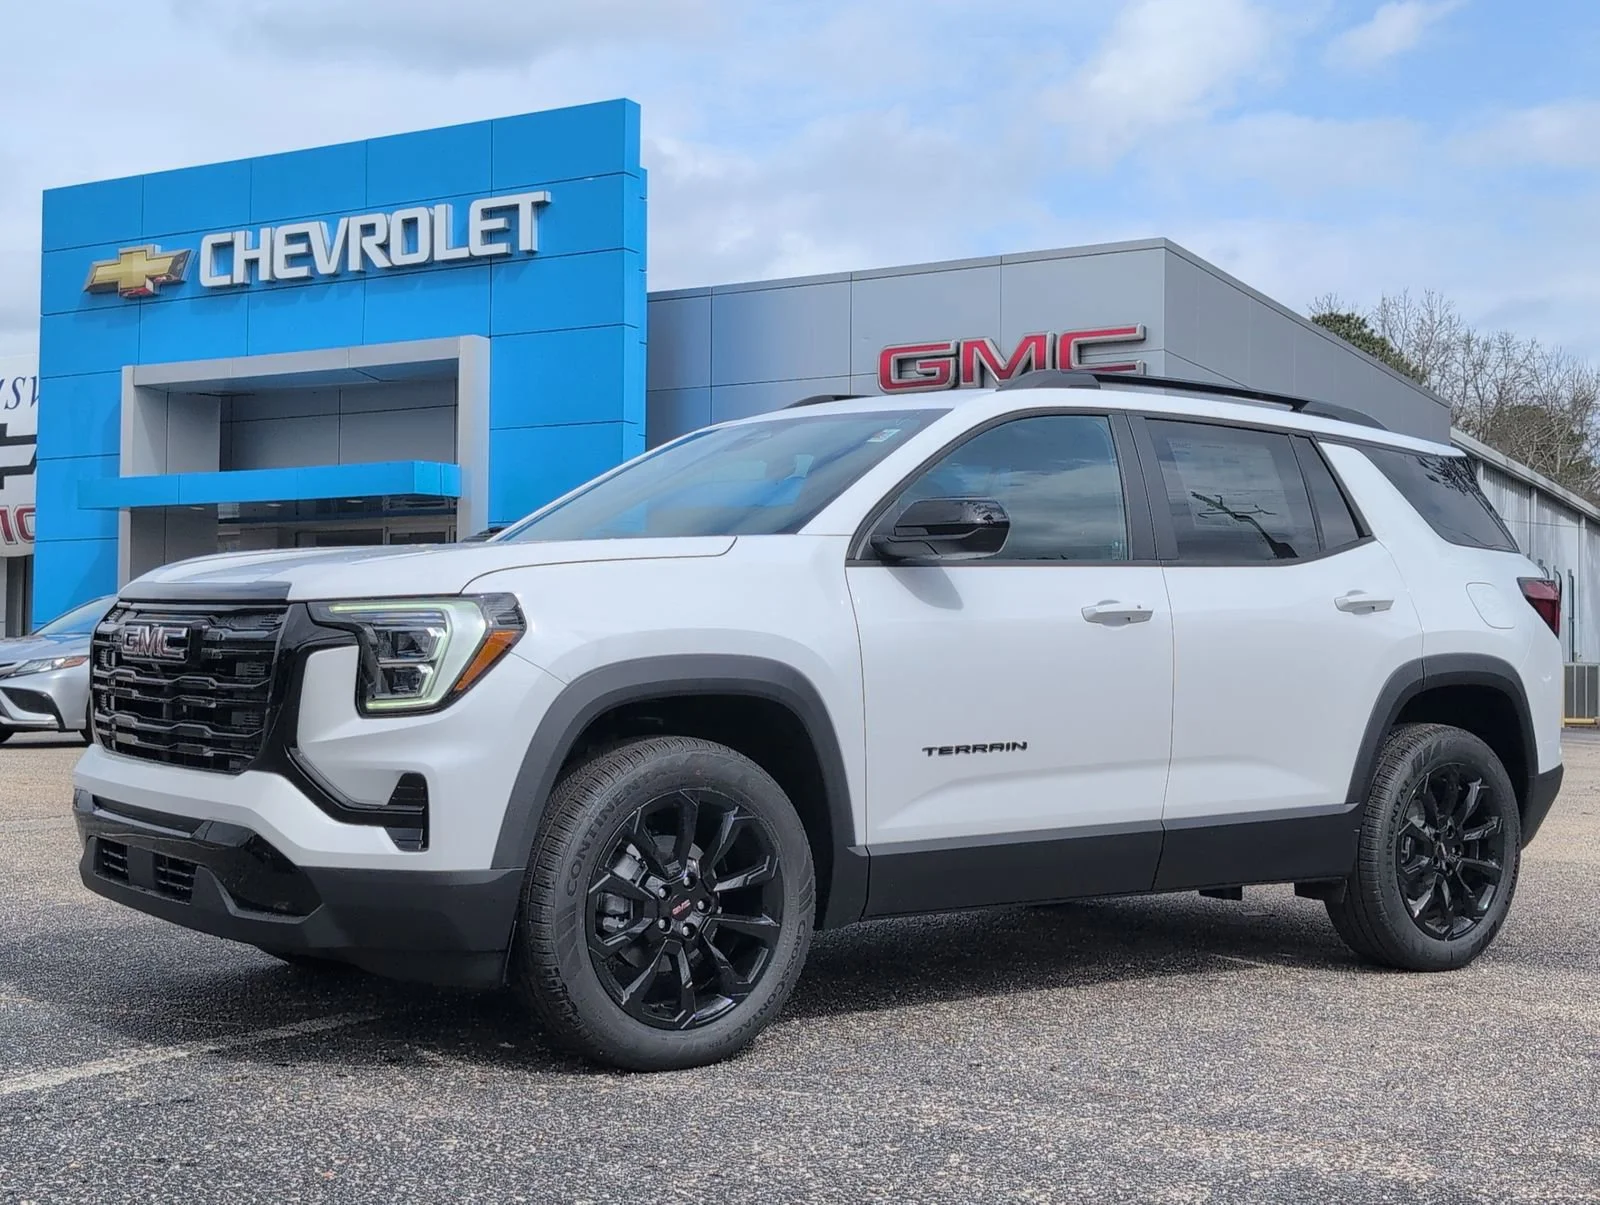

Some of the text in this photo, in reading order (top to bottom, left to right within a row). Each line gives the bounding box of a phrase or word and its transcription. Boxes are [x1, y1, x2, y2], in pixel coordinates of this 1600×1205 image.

[199, 190, 551, 288] CHEVROLET
[877, 323, 1146, 394] GMC
[122, 625, 188, 660] GMC
[921, 741, 1028, 757] TERRAIN
